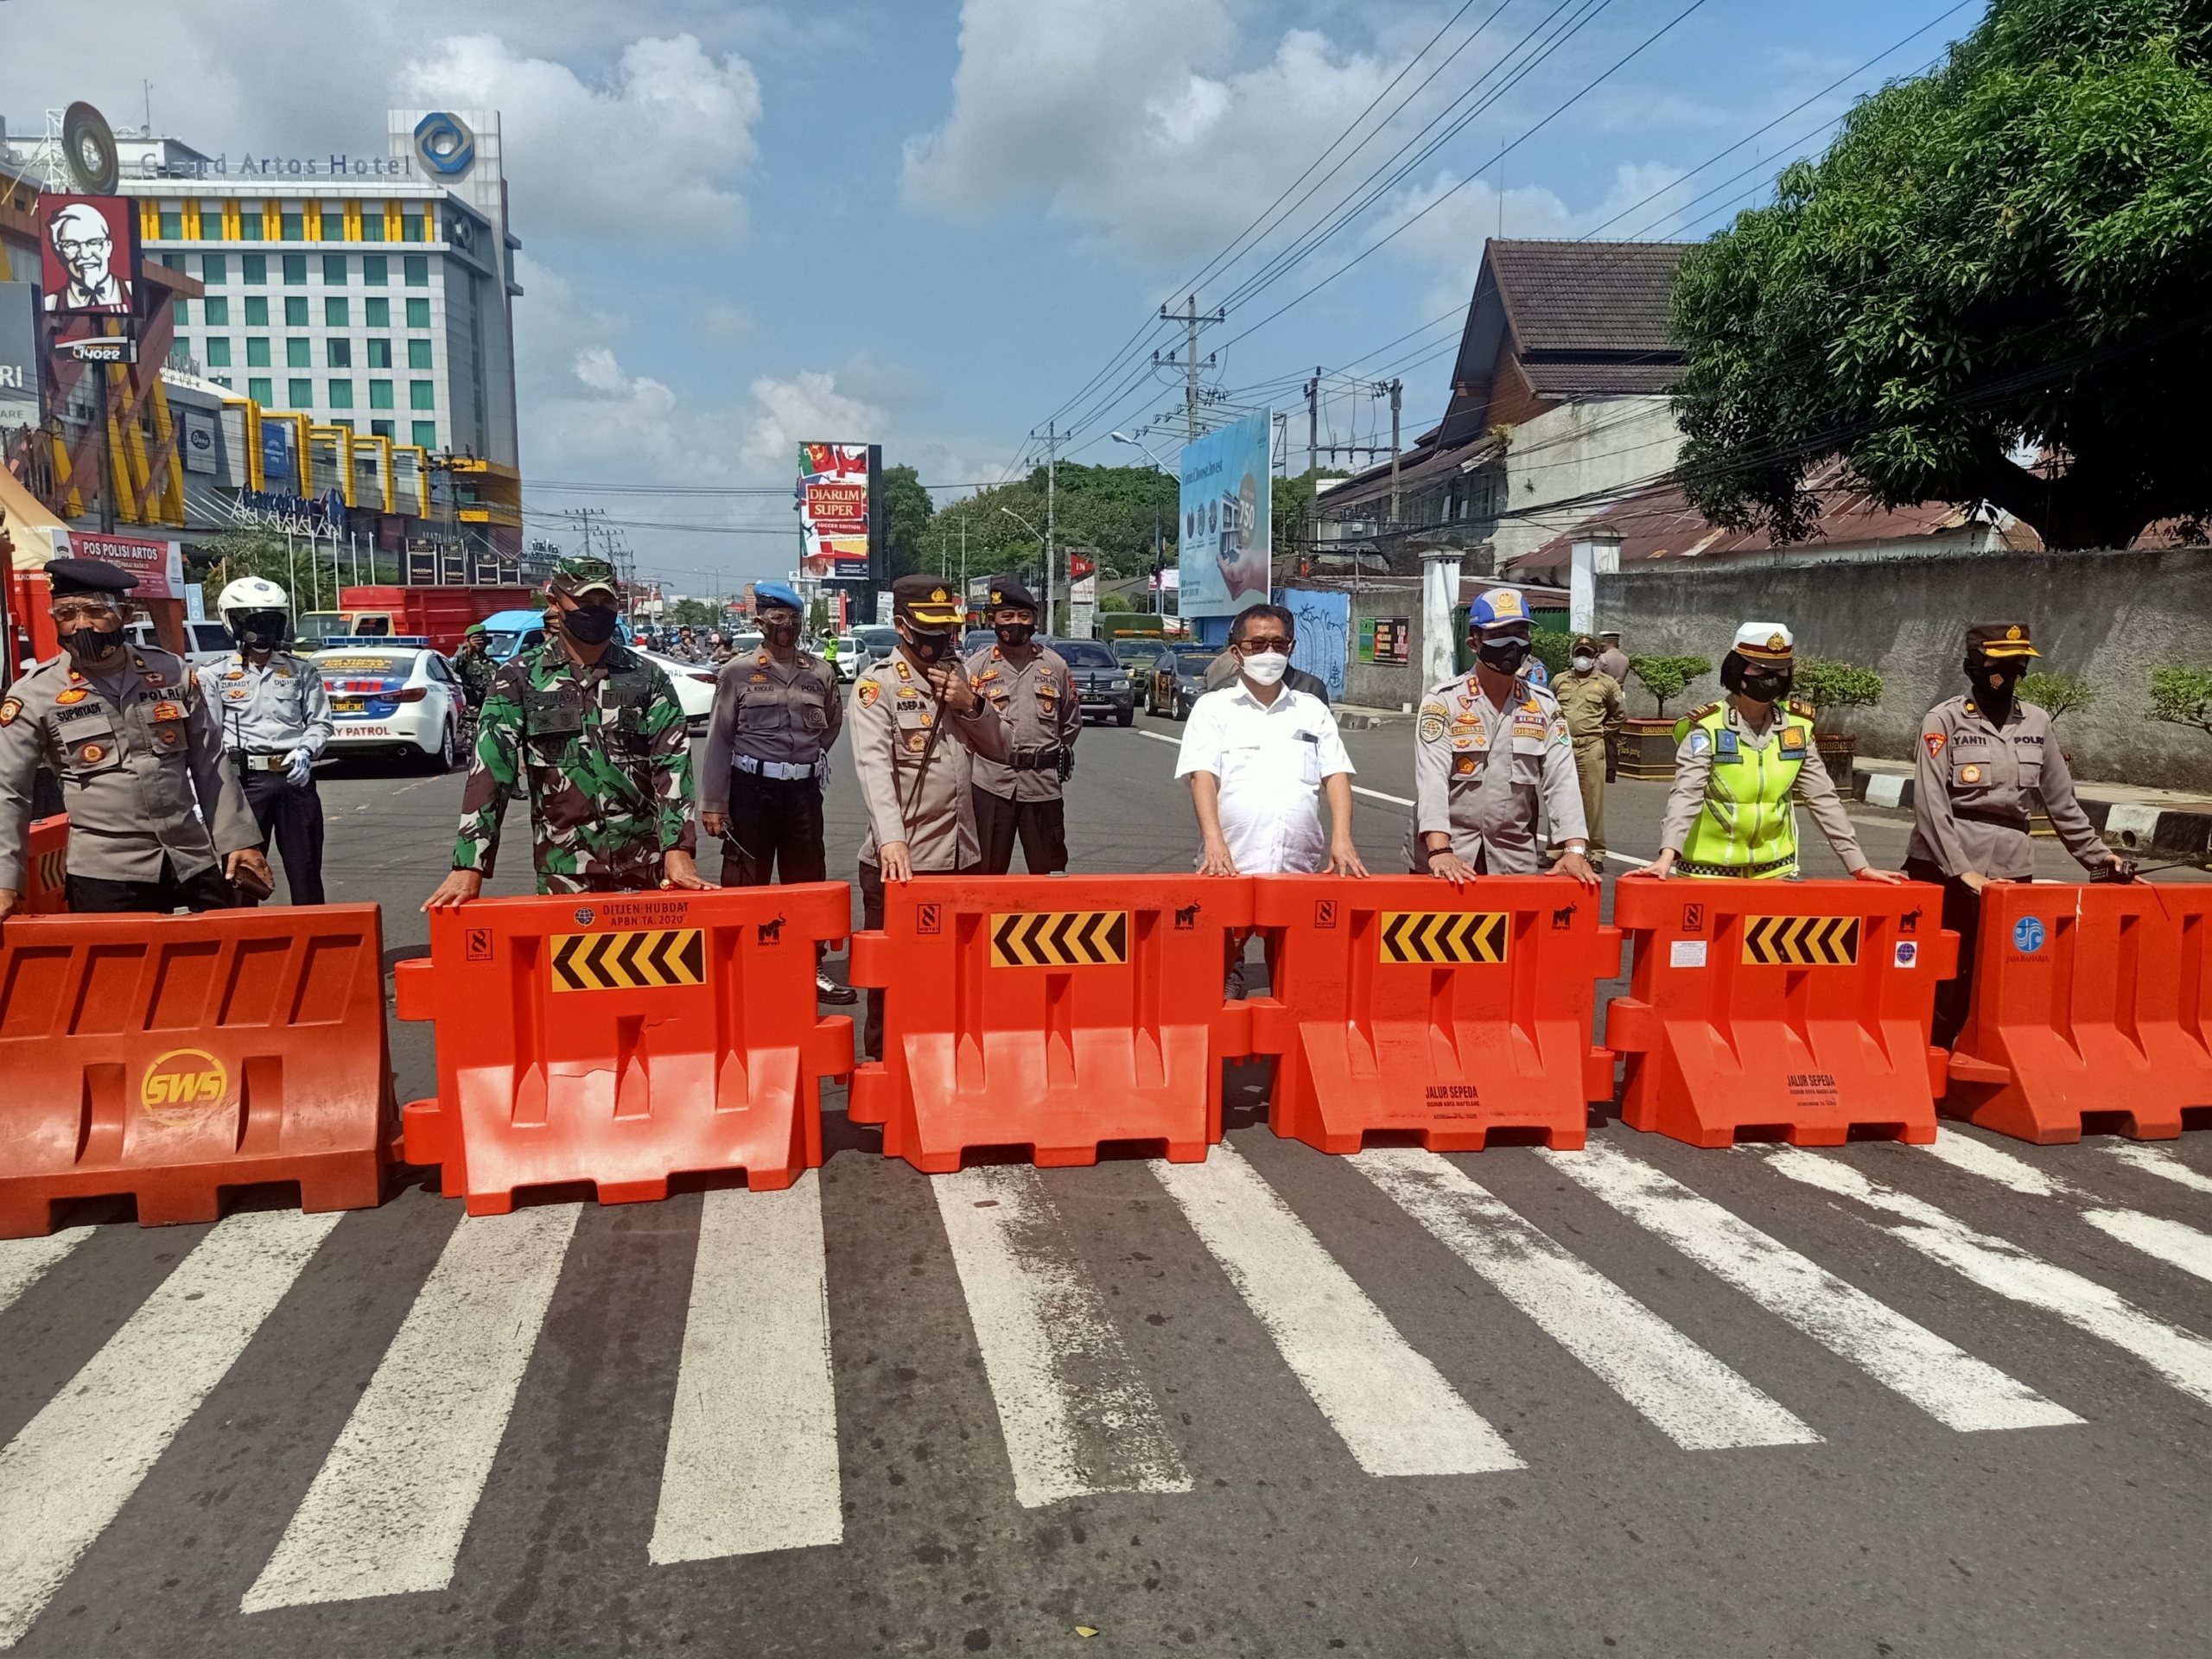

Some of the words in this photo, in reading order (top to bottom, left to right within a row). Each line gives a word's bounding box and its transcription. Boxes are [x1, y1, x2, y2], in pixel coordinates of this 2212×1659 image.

[141, 153, 226, 173] Grand
[239, 152, 315, 174] Artos
[330, 154, 410, 174] Hotel
[79, 349, 120, 359] 14022
[810, 489, 860, 501] DJARUM
[814, 505, 855, 516] SUPER
[1239, 499, 1255, 531] 750
[83, 541, 101, 556] POS
[103, 543, 130, 558] POLISI
[131, 546, 158, 560] ARTOS
[1076, 563, 1086, 571] IN
[221, 680, 251, 689] ZUBAEDY
[1034, 676, 1058, 686] POLRI
[139, 688, 181, 702] POLRI
[607, 692, 627, 702] TNI
[633, 696, 647, 704] AD
[56, 702, 102, 721] SUPRIYADI
[897, 701, 927, 711] ASEP.M
[346, 727, 391, 736] PATROL
[1515, 728, 1544, 739] DISHUB
[1953, 735, 1986, 745] YANTI
[2014, 736, 2044, 745] POLRI
[602, 905, 640, 916] DITJEN
[645, 902, 690, 914] HUBDAT
[610, 915, 638, 926] APBN
[659, 914, 683, 925] 2020
[2006, 955, 2020, 963] JASA
[1787, 1075, 1808, 1087] JALUR
[1808, 1075, 1835, 1086] SEPEDA
[147, 1071, 221, 1104] SWS
[1426, 1086, 1448, 1098] JALUR
[1449, 1085, 1478, 1098] SEPEDA
